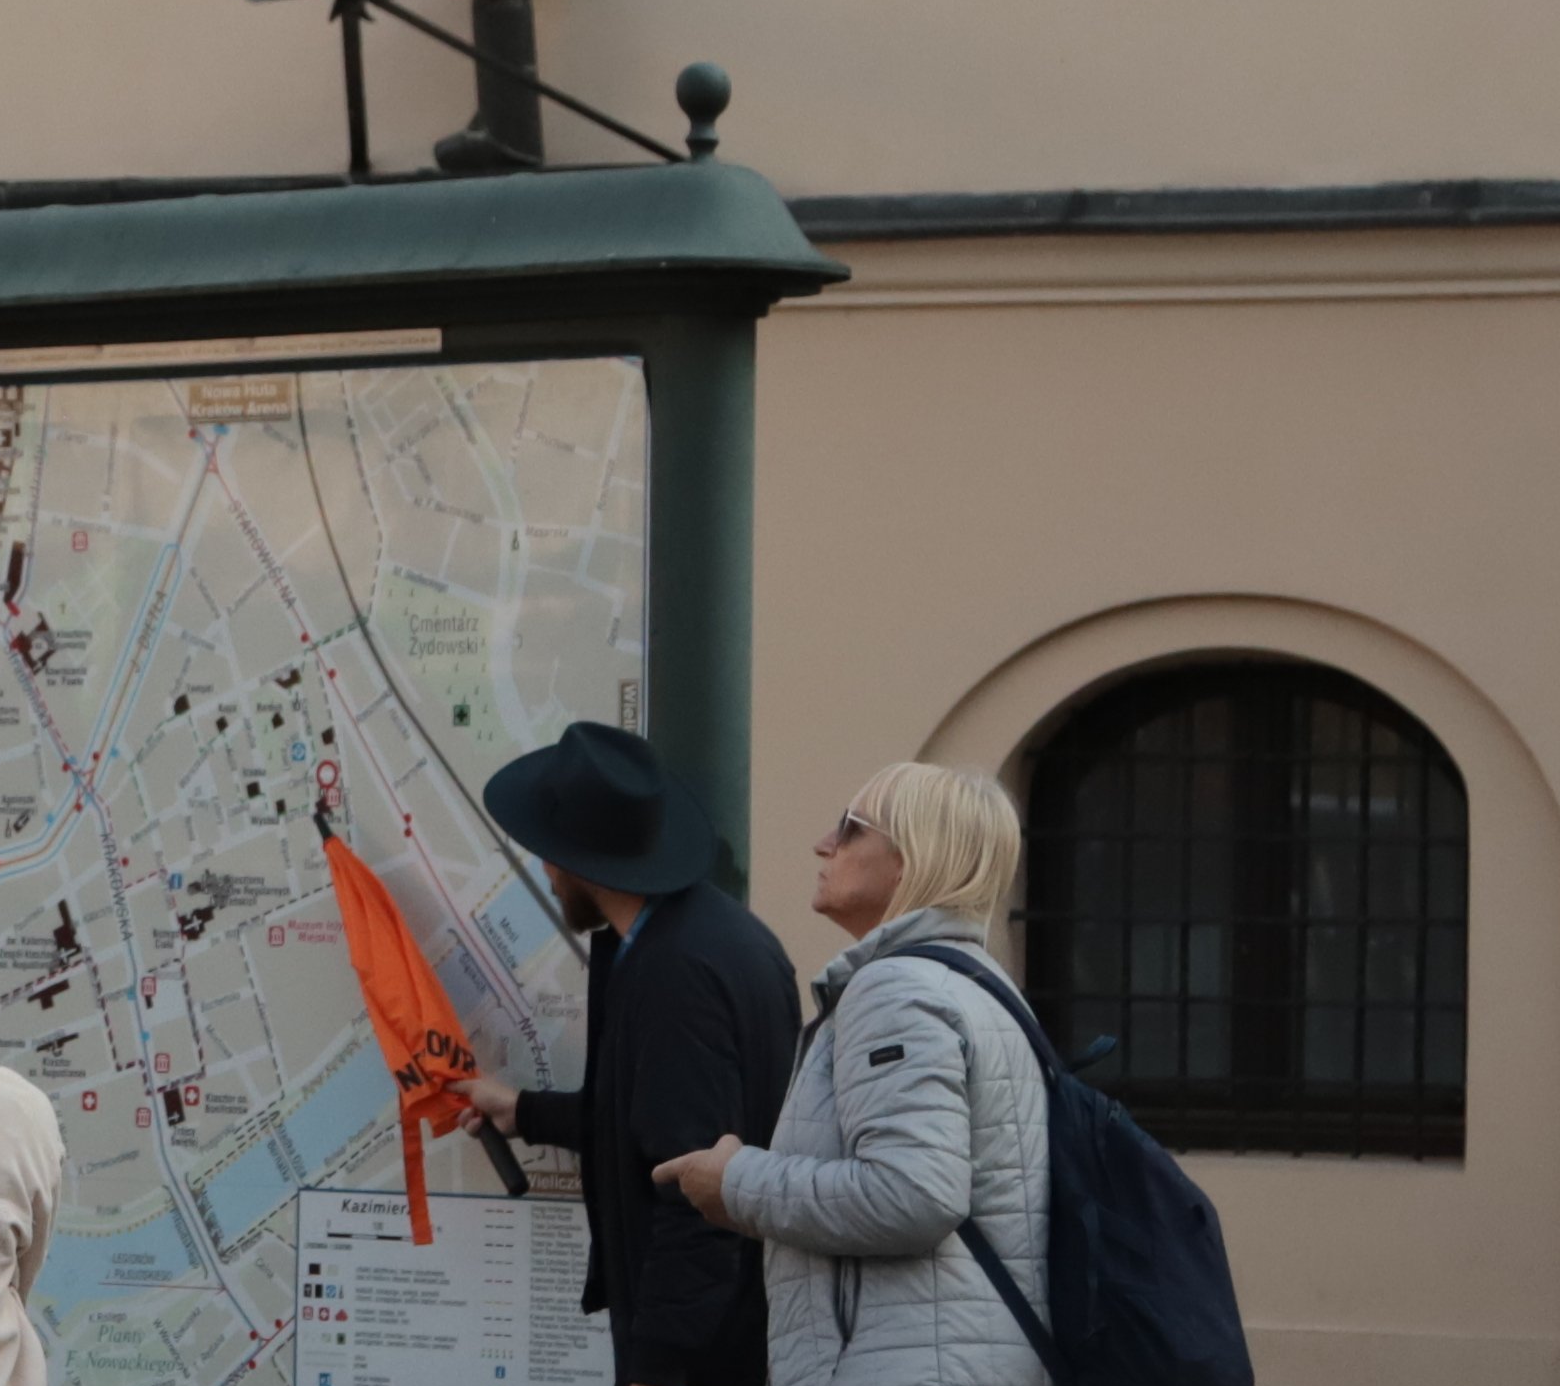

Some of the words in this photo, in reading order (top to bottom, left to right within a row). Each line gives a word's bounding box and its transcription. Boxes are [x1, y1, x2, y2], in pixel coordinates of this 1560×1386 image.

[202, 384, 240, 398] Nowa
[243, 382, 277, 397] Huta
[409, 613, 480, 633] Cmentarz
[408, 635, 479, 659] Żydowski
[100, 832, 133, 942] KRAKOWSKA
[341, 1197, 411, 1217] Kazimier
[97, 1324, 146, 1345] Planty
[87, 1351, 185, 1376] Nowackiego
